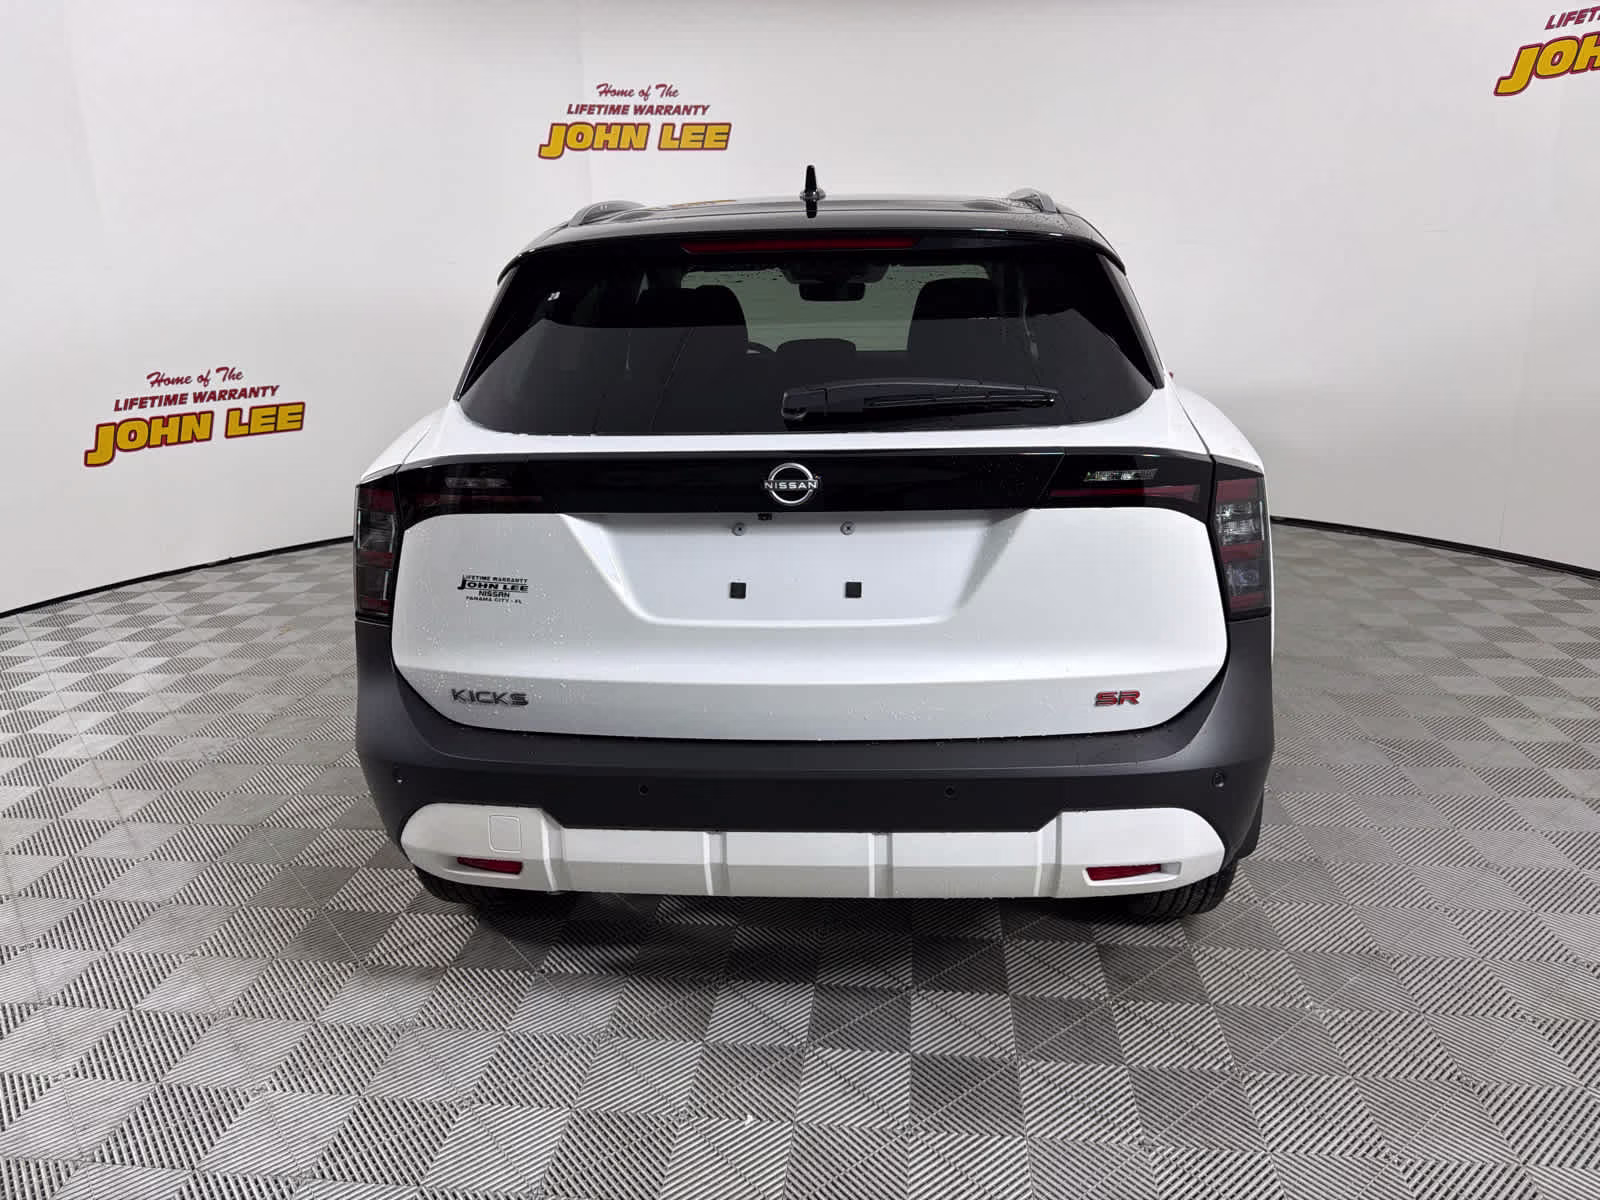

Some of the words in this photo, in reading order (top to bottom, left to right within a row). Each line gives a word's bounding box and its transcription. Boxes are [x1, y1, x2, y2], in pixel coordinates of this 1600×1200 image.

[1544, 6, 1600, 30] LIFET
[596, 83, 635, 98] Home
[638, 84, 652, 101] of
[655, 83, 679, 98] The
[567, 104, 630, 115] LIFETIME
[633, 104, 710, 116] WARRANTY
[538, 122, 650, 160] JOHN
[658, 122, 732, 151] LEE
[146, 371, 193, 387] Home
[197, 369, 211, 387] of
[215, 366, 243, 382] The
[114, 393, 188, 412] LIFETIME
[193, 385, 280, 404] WARRANTY
[84, 410, 214, 467] JOHN
[224, 402, 305, 439] LEE
[764, 481, 817, 489] NISSAN
[457, 577, 498, 590] JOHN
[451, 688, 529, 706] KICKS
[1094, 690, 1140, 707] SR
